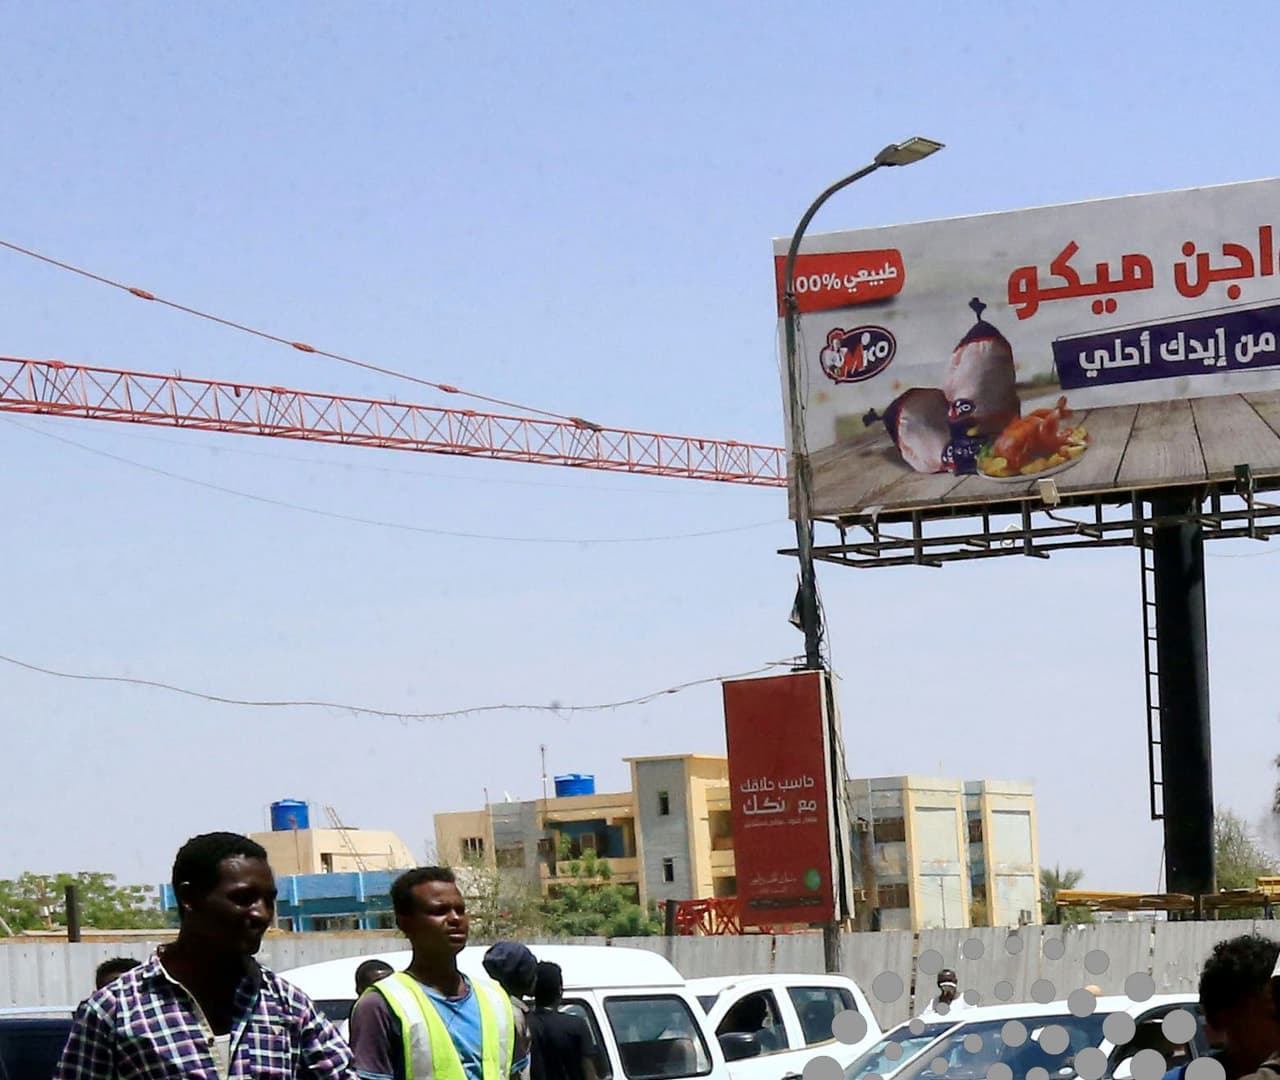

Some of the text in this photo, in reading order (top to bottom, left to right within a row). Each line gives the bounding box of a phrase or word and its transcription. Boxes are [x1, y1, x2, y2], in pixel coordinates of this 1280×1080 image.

[844, 262, 897, 293] طبيعي
[1008, 240, 1153, 320] ميكو
[1160, 327, 1226, 366] إيدك
[1235, 331, 1276, 360] من
[740, 774, 815, 793] حاسب حلاقك
[798, 799, 817, 815] مع
